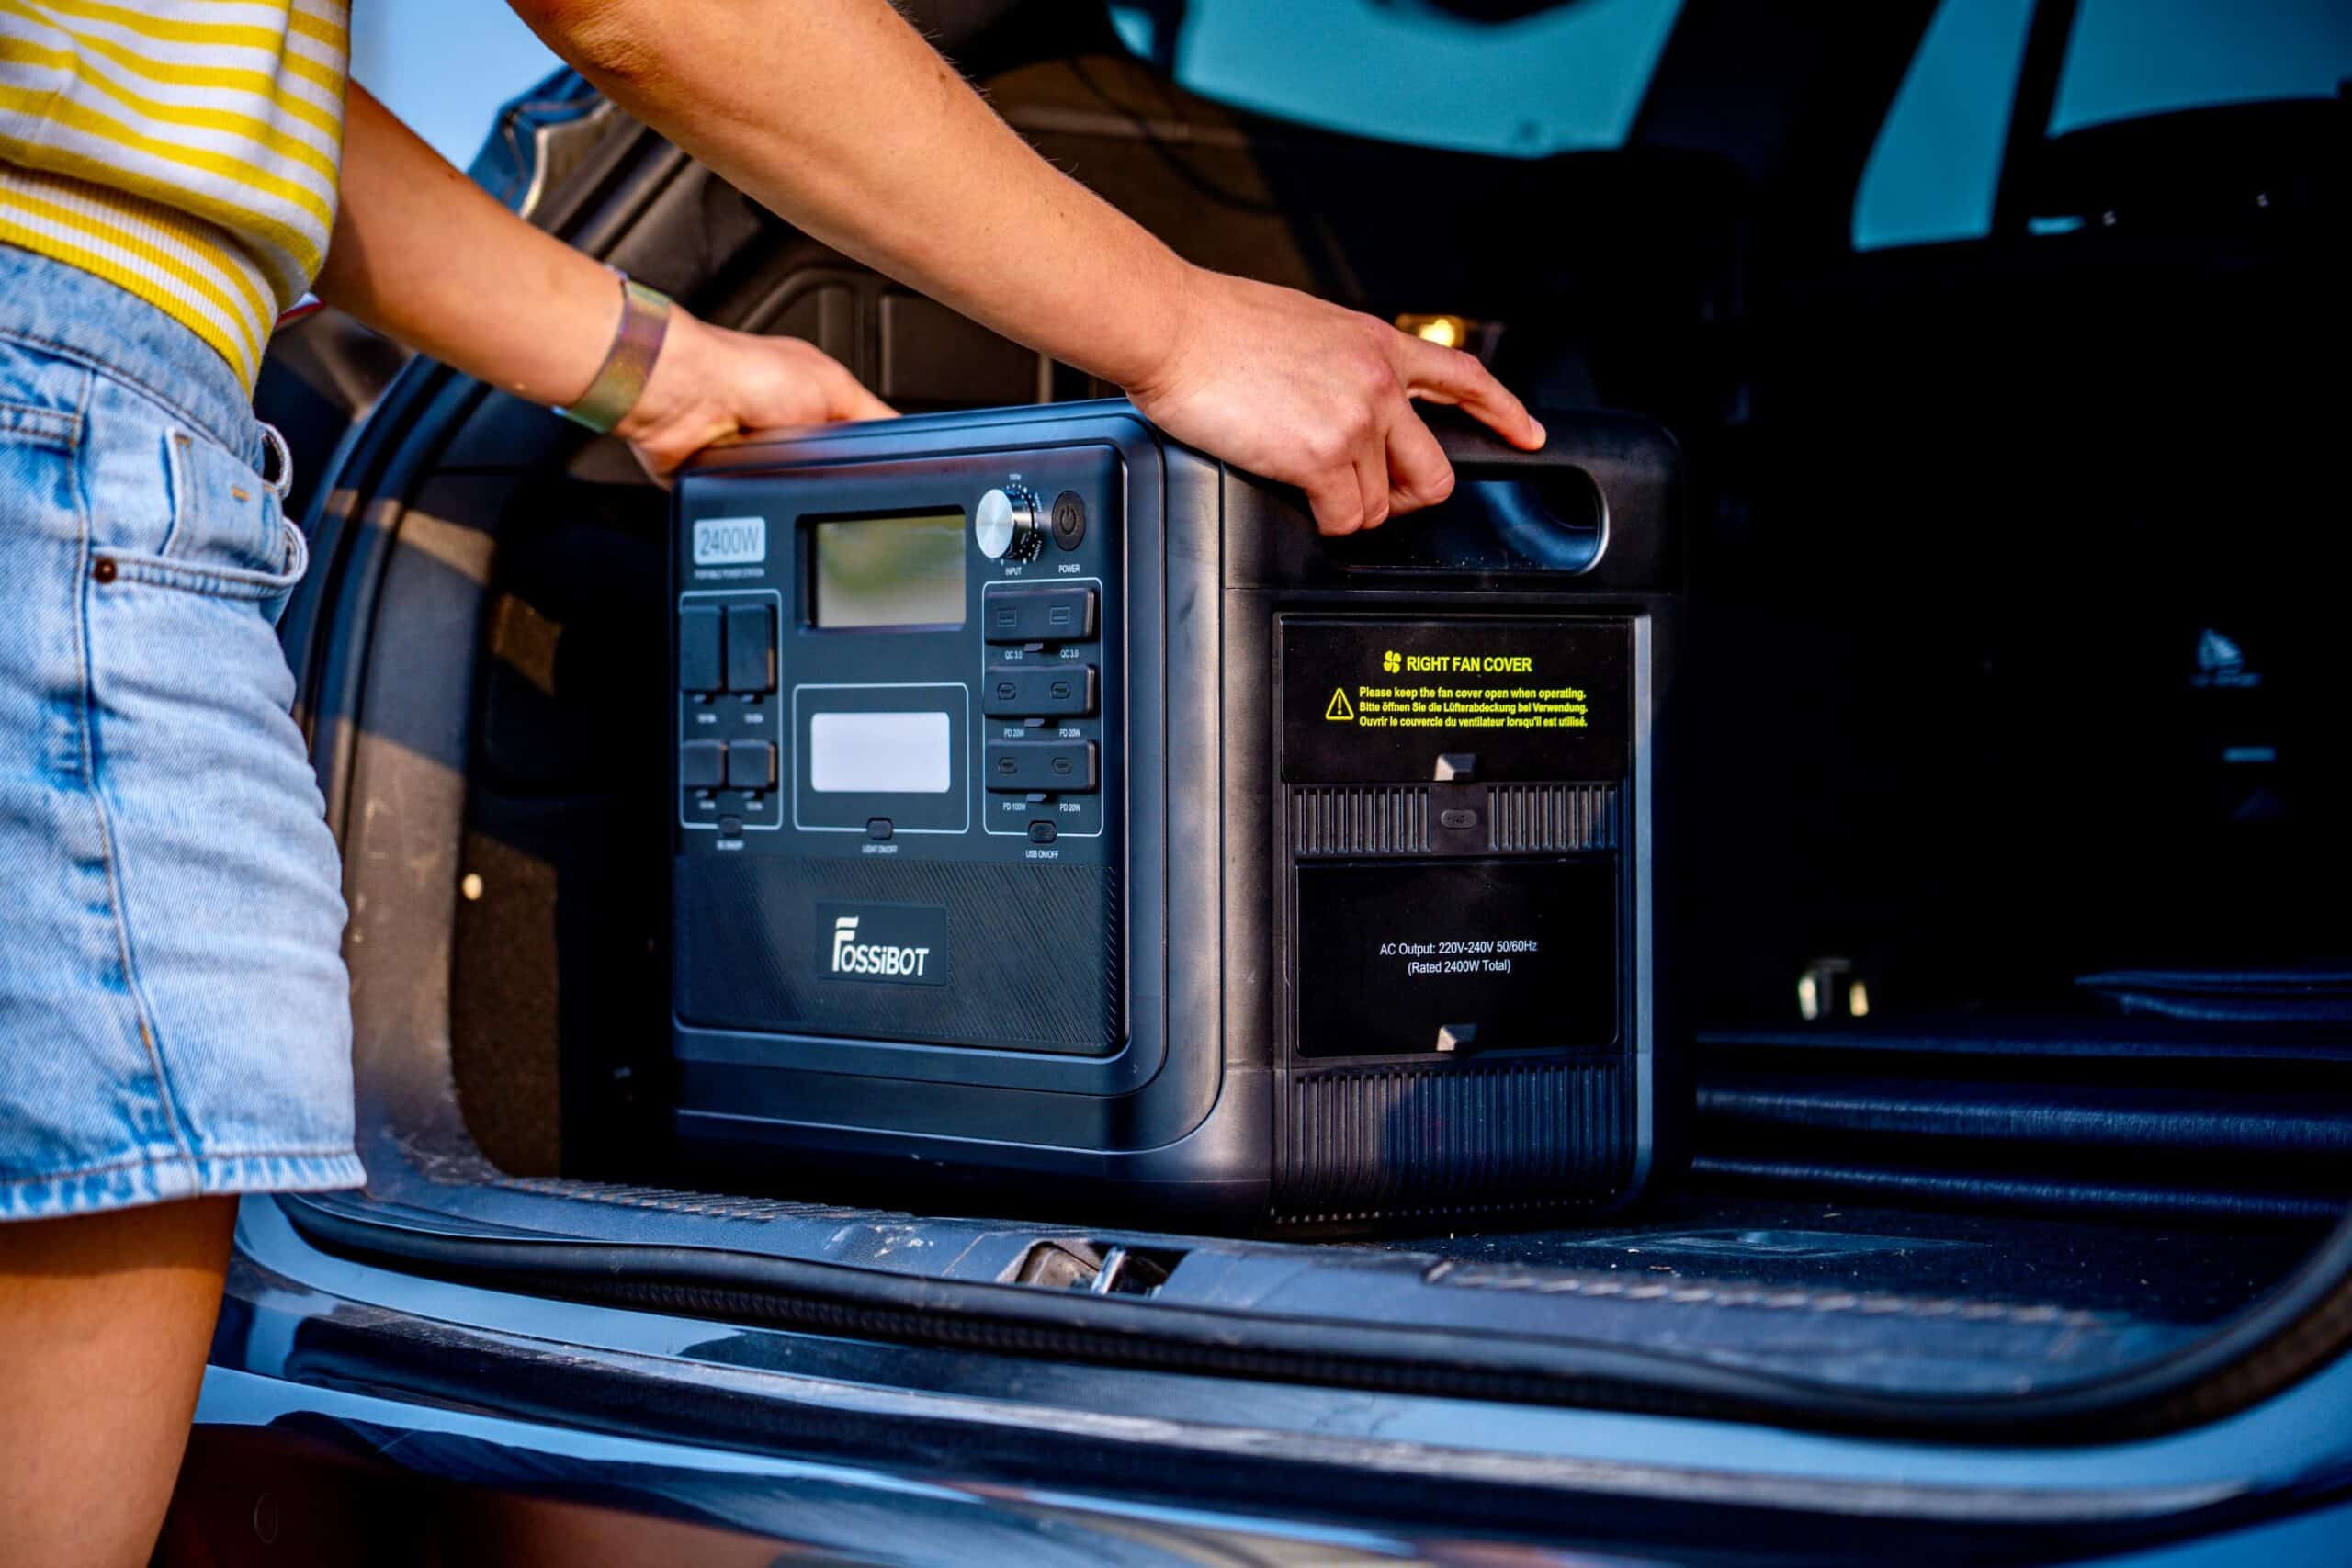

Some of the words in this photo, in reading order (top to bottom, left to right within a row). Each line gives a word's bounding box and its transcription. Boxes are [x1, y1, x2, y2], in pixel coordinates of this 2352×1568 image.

[700, 526, 759, 556] 2400W
[1005, 567, 1022, 576] INPUT
[1059, 564, 1080, 573] POWER
[1407, 656, 1450, 671] RIGHT
[1453, 656, 1480, 671] FAN
[1484, 656, 1532, 672] COVER
[1360, 686, 1392, 698] Please
[1394, 686, 1418, 700] keep
[1420, 687, 1435, 698] the
[1438, 687, 1453, 698] fan
[1455, 689, 1483, 698] cover
[1485, 689, 1509, 701] open
[1510, 687, 1536, 698] when
[1538, 687, 1586, 701] operating.
[1360, 701, 1380, 712] Bitte
[1382, 702, 1410, 712] öffnen
[1412, 702, 1426, 712] Sie
[1428, 702, 1442, 712] die
[1443, 702, 1516, 715] Lüfterabdeckung
[1518, 702, 1532, 713] bei
[1532, 702, 1588, 715] Verwendung.
[1360, 716, 1387, 727] Ouvrir
[1390, 716, 1397, 727] le
[1400, 716, 1442, 727] couvercle
[1445, 716, 1456, 727] du
[1458, 716, 1505, 727] ventilateur
[1507, 716, 1542, 728] lorsqu'il
[1544, 717, 1557, 727] est
[1559, 716, 1588, 727] utilisé.
[1380, 943, 1396, 955] AC
[1398, 942, 1436, 957] Output:
[1438, 942, 1494, 954] 220V-240V
[1496, 940, 1538, 953] 50/60Hz
[1408, 962, 1442, 976] (Rated
[1444, 960, 1480, 974] 2400W
[1482, 959, 1511, 974] Total)
